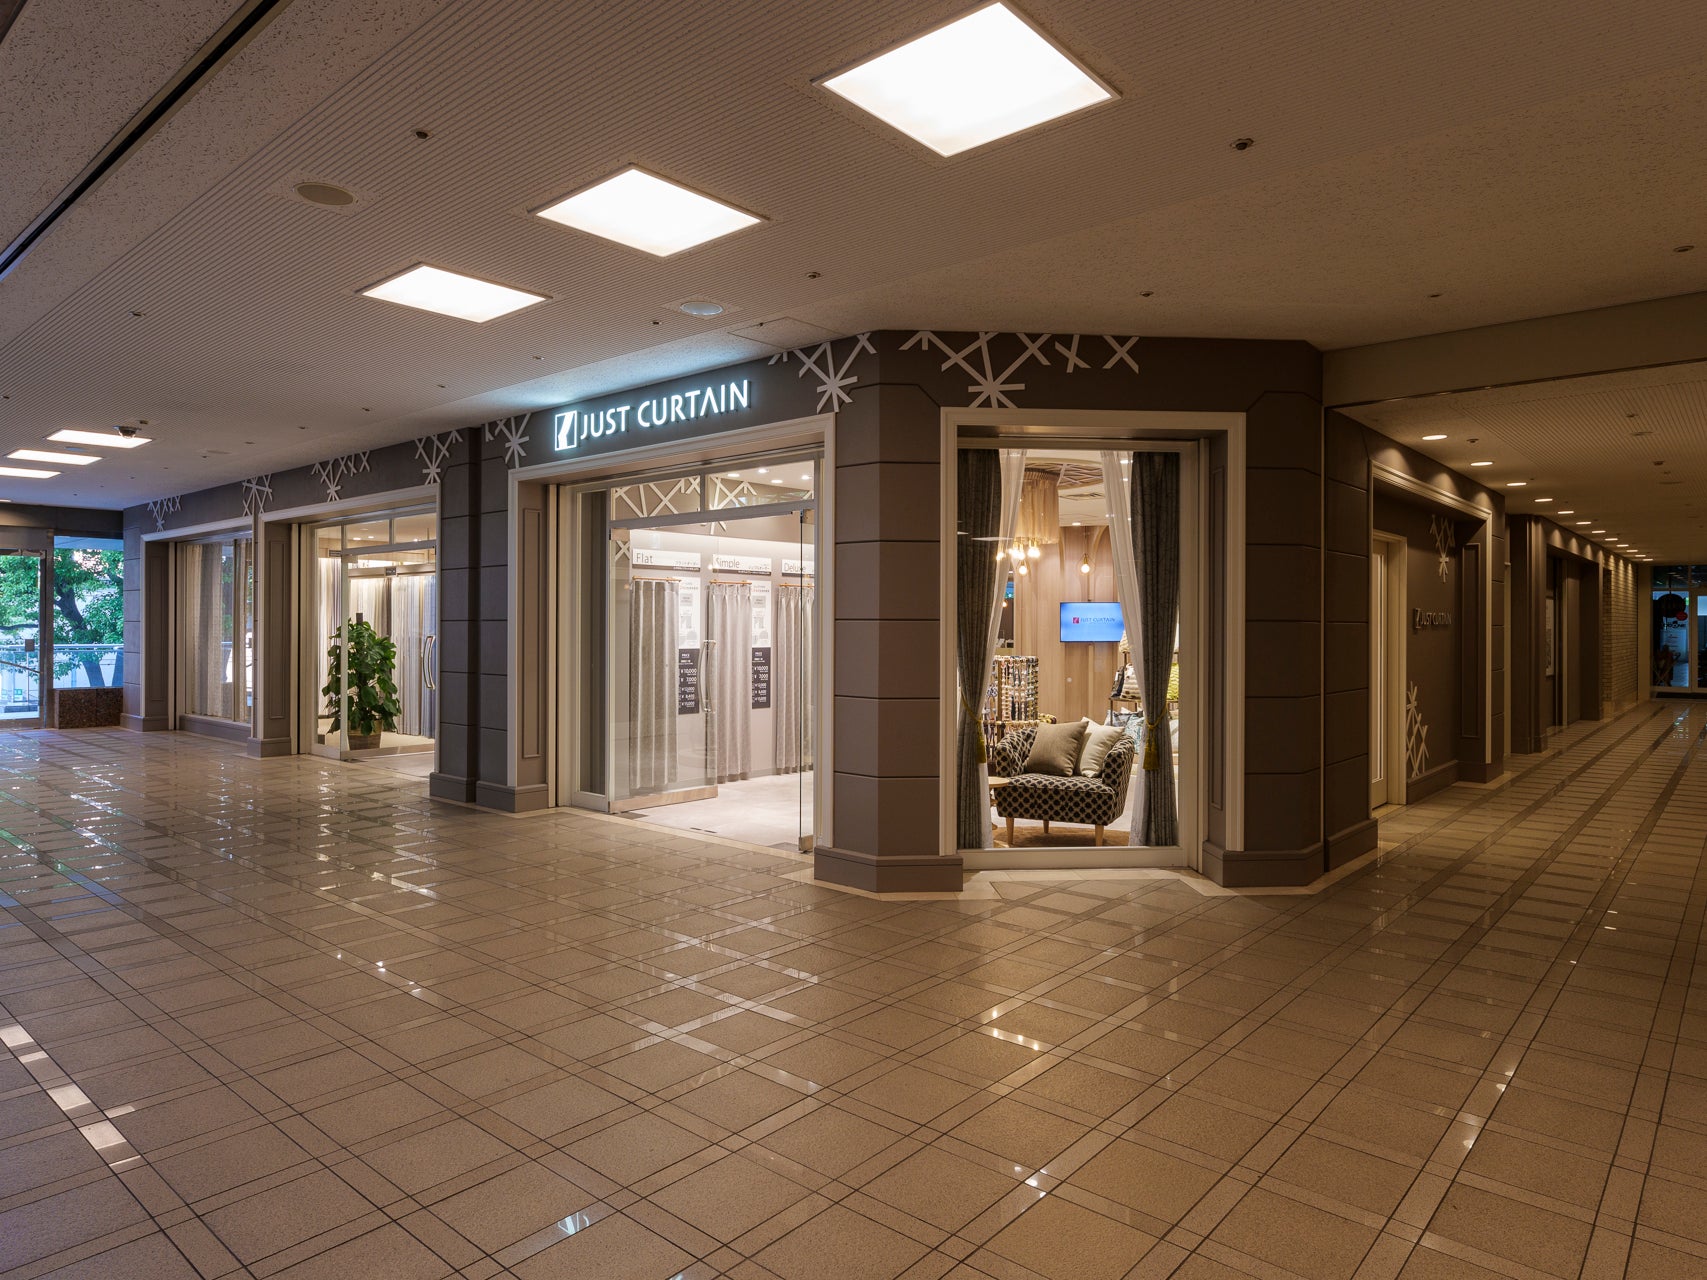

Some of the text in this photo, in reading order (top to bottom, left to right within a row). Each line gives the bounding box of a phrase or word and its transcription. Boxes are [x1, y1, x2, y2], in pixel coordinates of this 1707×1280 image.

[580, 379, 749, 440] JUST CURTAIN
[636, 552, 654, 564] Flat
[715, 557, 741, 569] Simple
